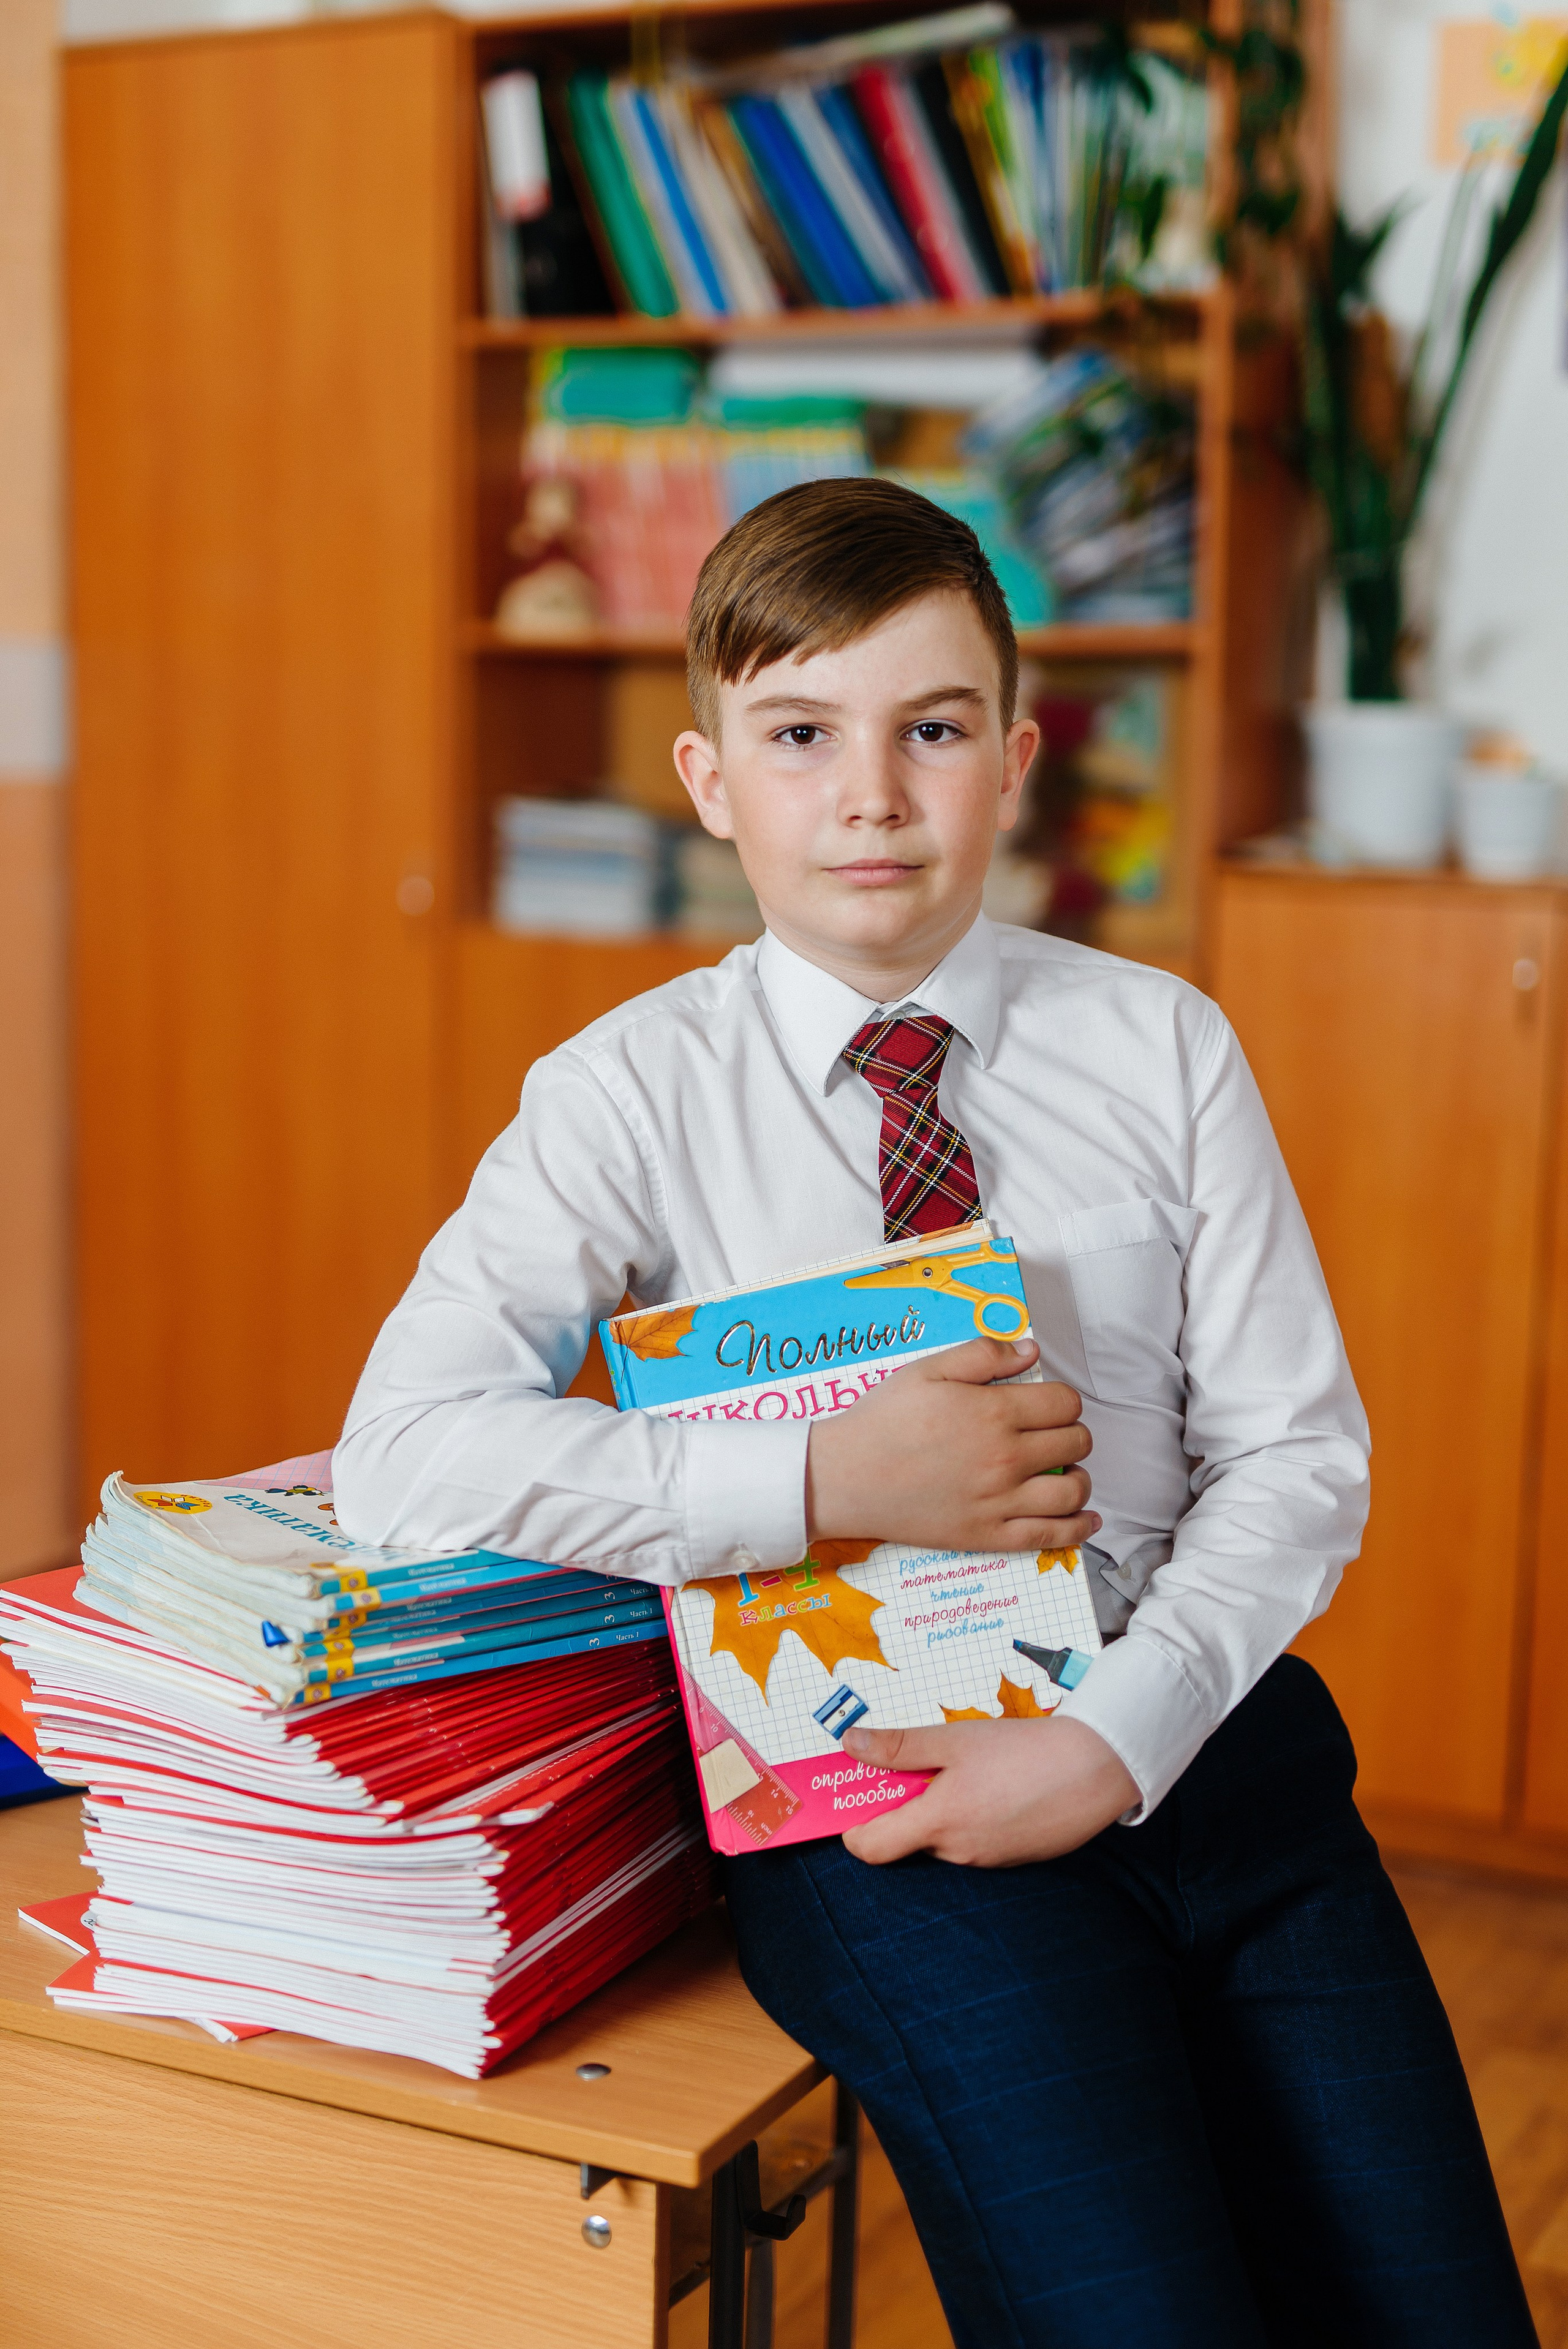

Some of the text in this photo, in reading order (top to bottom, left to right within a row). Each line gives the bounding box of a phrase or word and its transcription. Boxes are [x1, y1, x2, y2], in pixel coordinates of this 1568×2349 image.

[715, 1305, 925, 1376] Полный
[900, 1559, 1008, 1589] математика
[604, 1592, 615, 1601] 3
[930, 1583, 984, 1602] чтение
[604, 1614, 615, 1624] 3
[905, 1595, 1019, 1632] природоведение
[589, 1637, 600, 1647] 3
[927, 1618, 1005, 1648] рисование
[812, 1761, 897, 1792] справо
[834, 1779, 906, 1811] пособие
